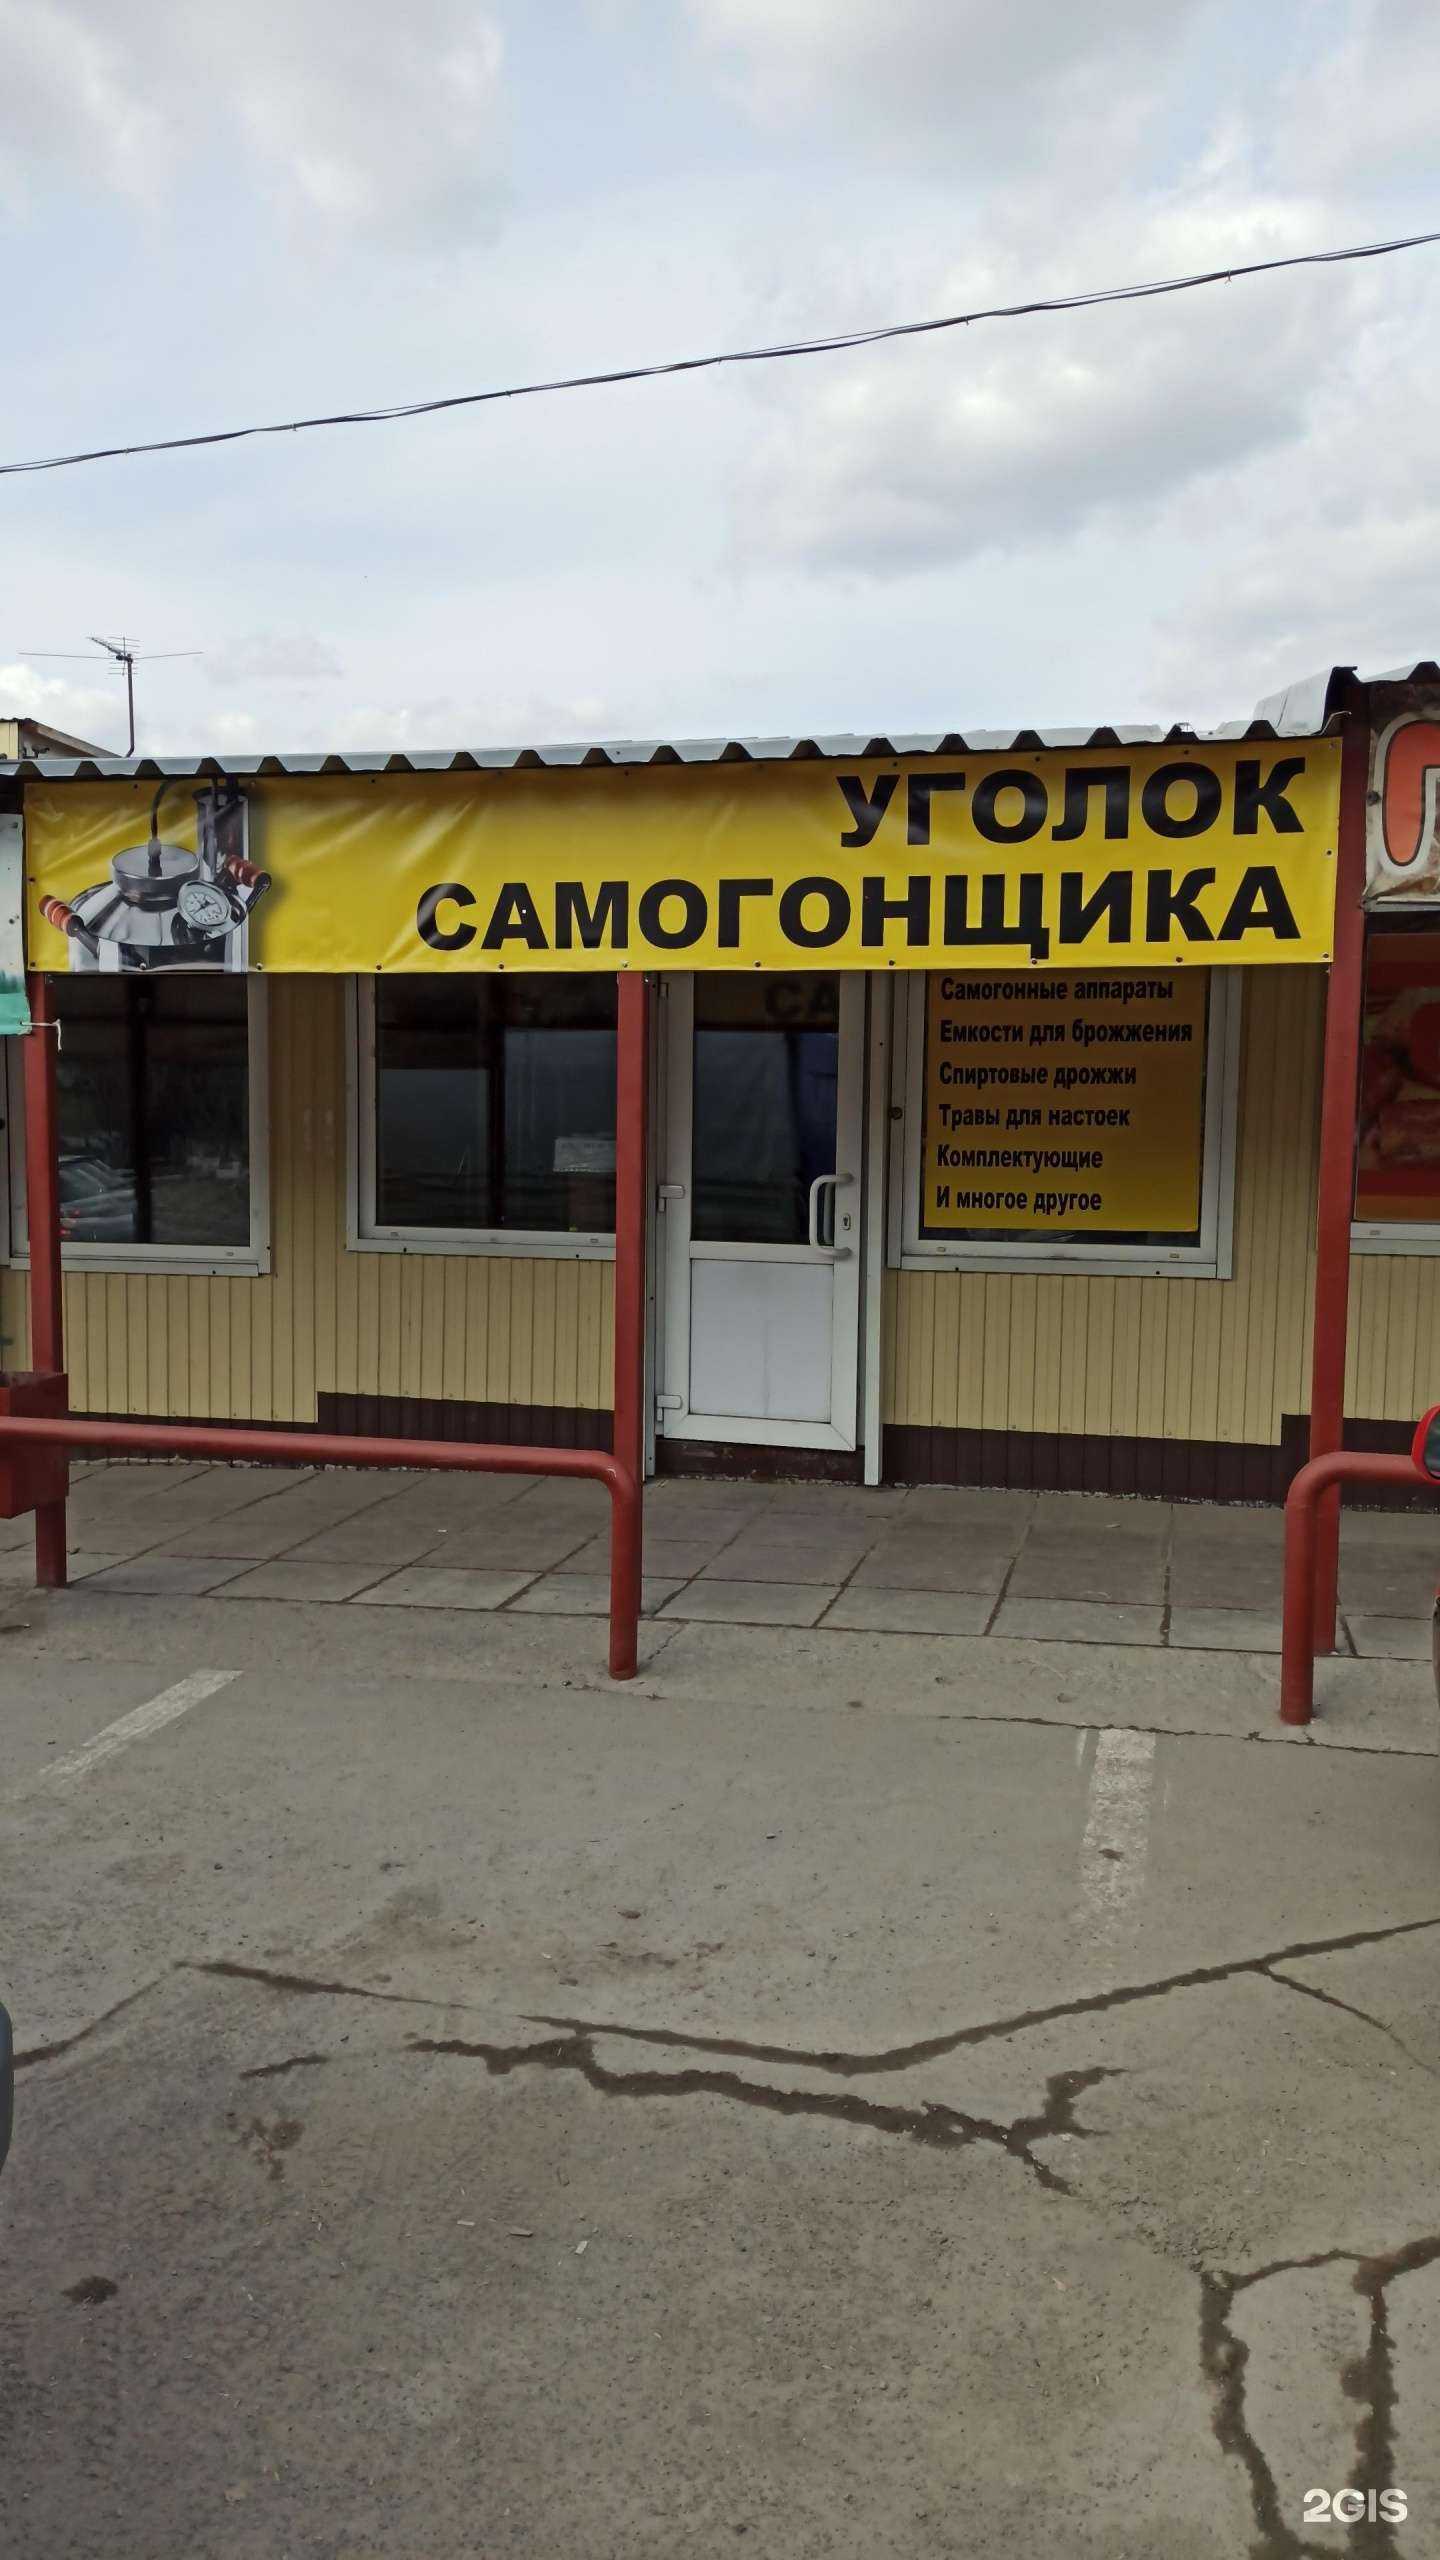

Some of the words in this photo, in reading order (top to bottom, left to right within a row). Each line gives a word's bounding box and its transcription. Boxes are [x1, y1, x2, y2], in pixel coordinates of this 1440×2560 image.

[836, 756, 1306, 848] УГОЛОК
[416, 865, 1301, 960] САМОГОНЩИКА
[940, 977, 1068, 1001] Самогонные
[1074, 980, 1174, 1004] аппараты
[939, 1019, 1024, 1043] Емкости
[1029, 1023, 1066, 1047] для
[1071, 1018, 1193, 1047] брожжения
[939, 1061, 1049, 1090] Спиртовые
[1053, 1066, 1137, 1090] дрожжи
[938, 1103, 1000, 1131] Травы
[1005, 1108, 1042, 1130] для
[1048, 1108, 1131, 1126] настоек
[936, 1144, 1104, 1173] Комплектующие
[936, 1185, 950, 1208] И
[956, 1190, 1028, 1210] многое
[1033, 1190, 1102, 1216] другое
